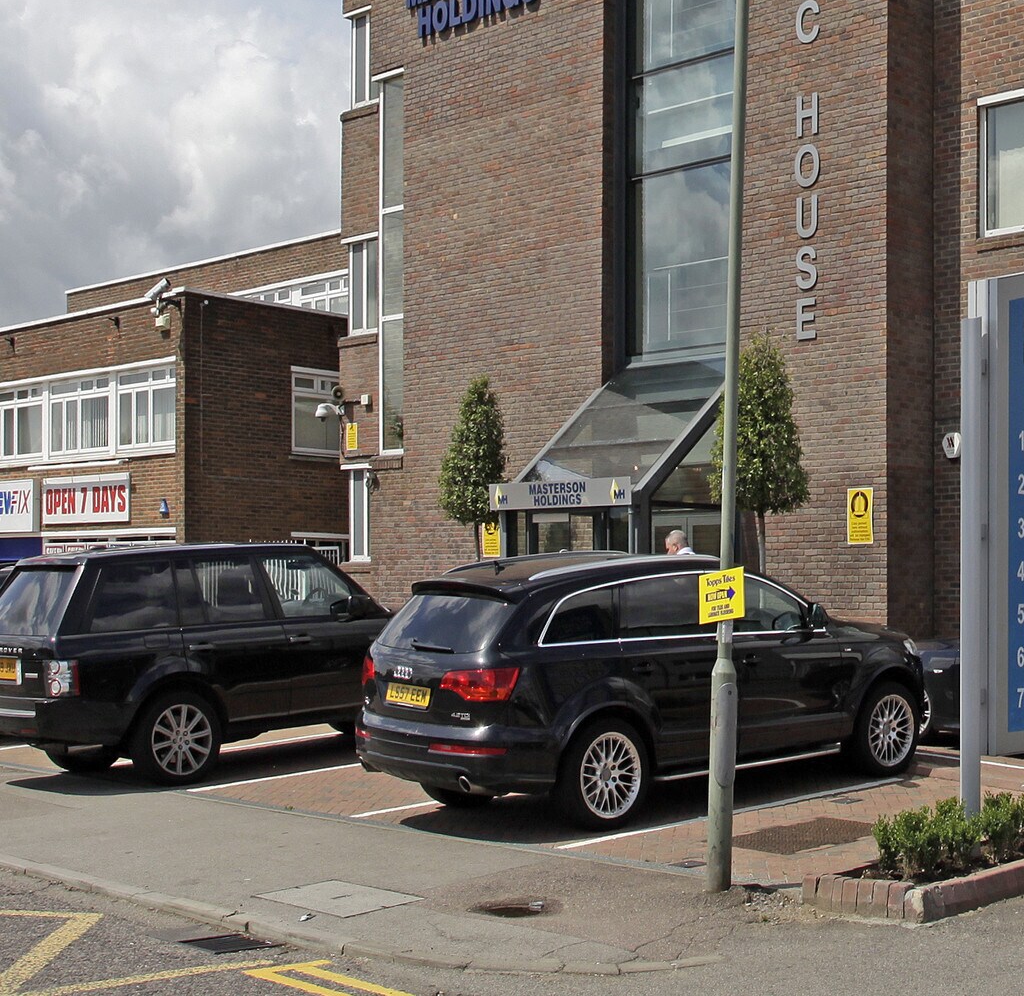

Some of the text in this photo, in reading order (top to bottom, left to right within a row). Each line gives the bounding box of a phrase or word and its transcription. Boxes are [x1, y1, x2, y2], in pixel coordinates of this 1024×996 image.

[794, 91, 820, 341] HOUSE
[1018, 430, 1024, 452] 1
[528, 481, 586, 496] MASTERSON
[46, 484, 126, 515] OPEN 7 DAYS
[533, 493, 582, 507] HOLDINGS
[1017, 604, 1024, 624] 5
[1017, 646, 1024, 668] 6
[1016, 688, 1024, 708] 7
